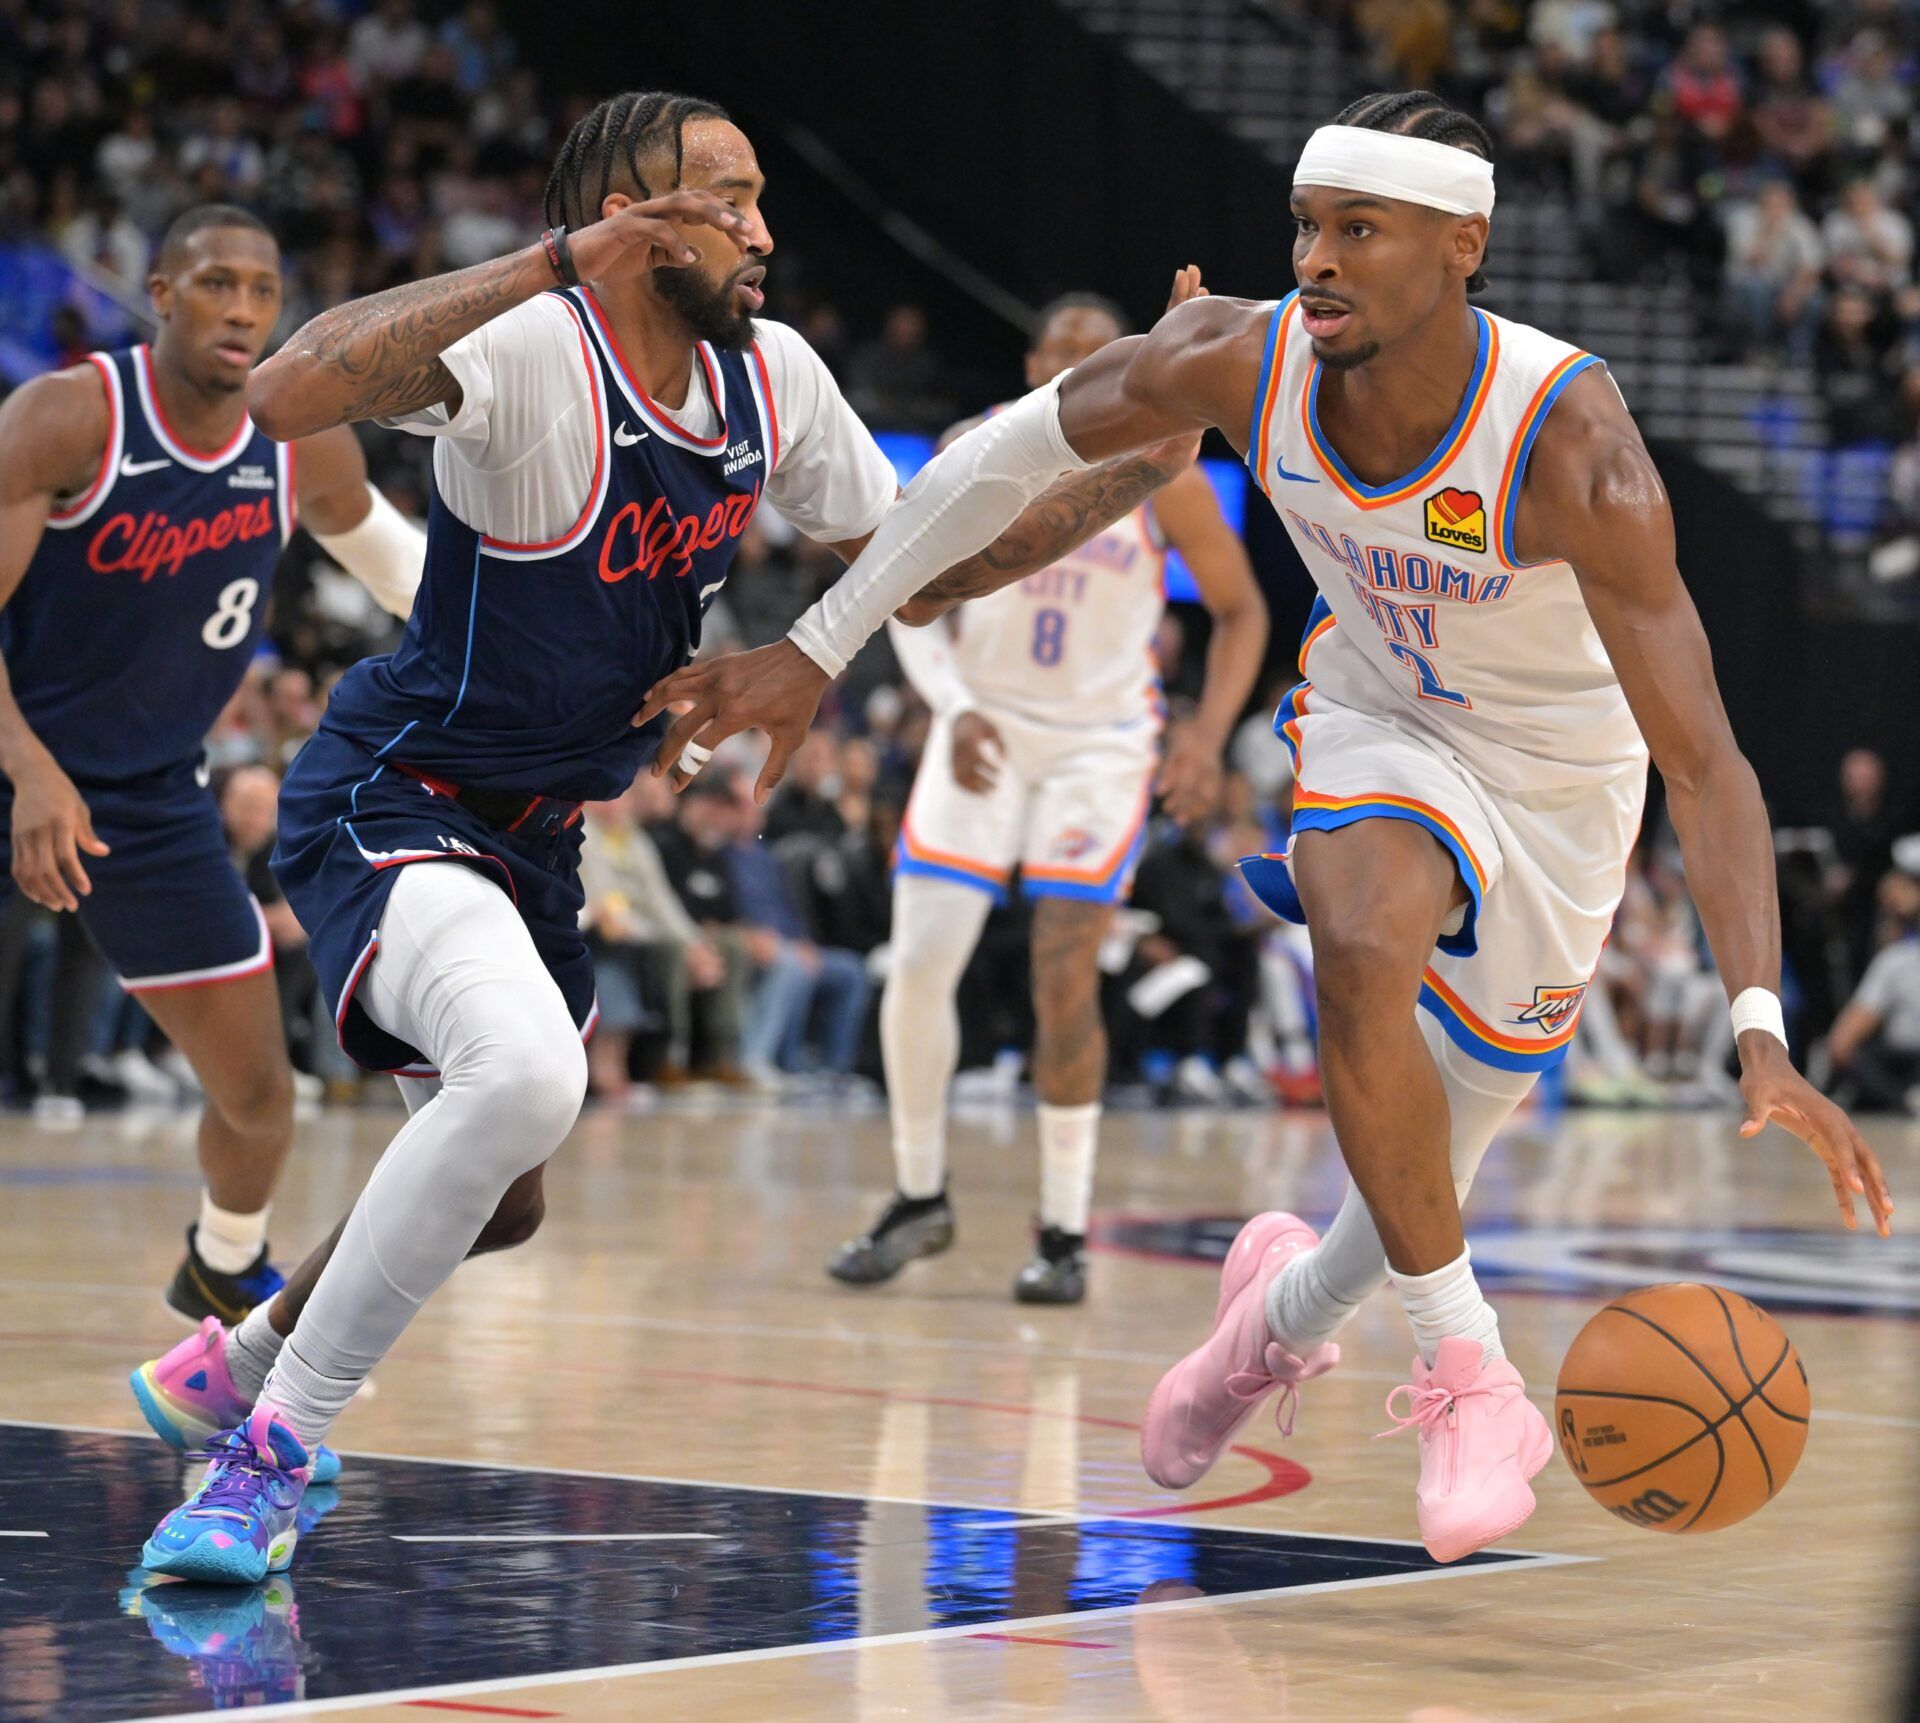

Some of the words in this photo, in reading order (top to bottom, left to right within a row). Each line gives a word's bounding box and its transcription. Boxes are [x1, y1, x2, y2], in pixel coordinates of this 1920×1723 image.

[723, 449, 763, 477] RWANDA
[726, 439, 749, 459] VISIT
[87, 497, 273, 582] Clippers
[202, 577, 259, 649] 8
[1031, 607, 1067, 667] 8
[1384, 637, 1473, 711] 2
